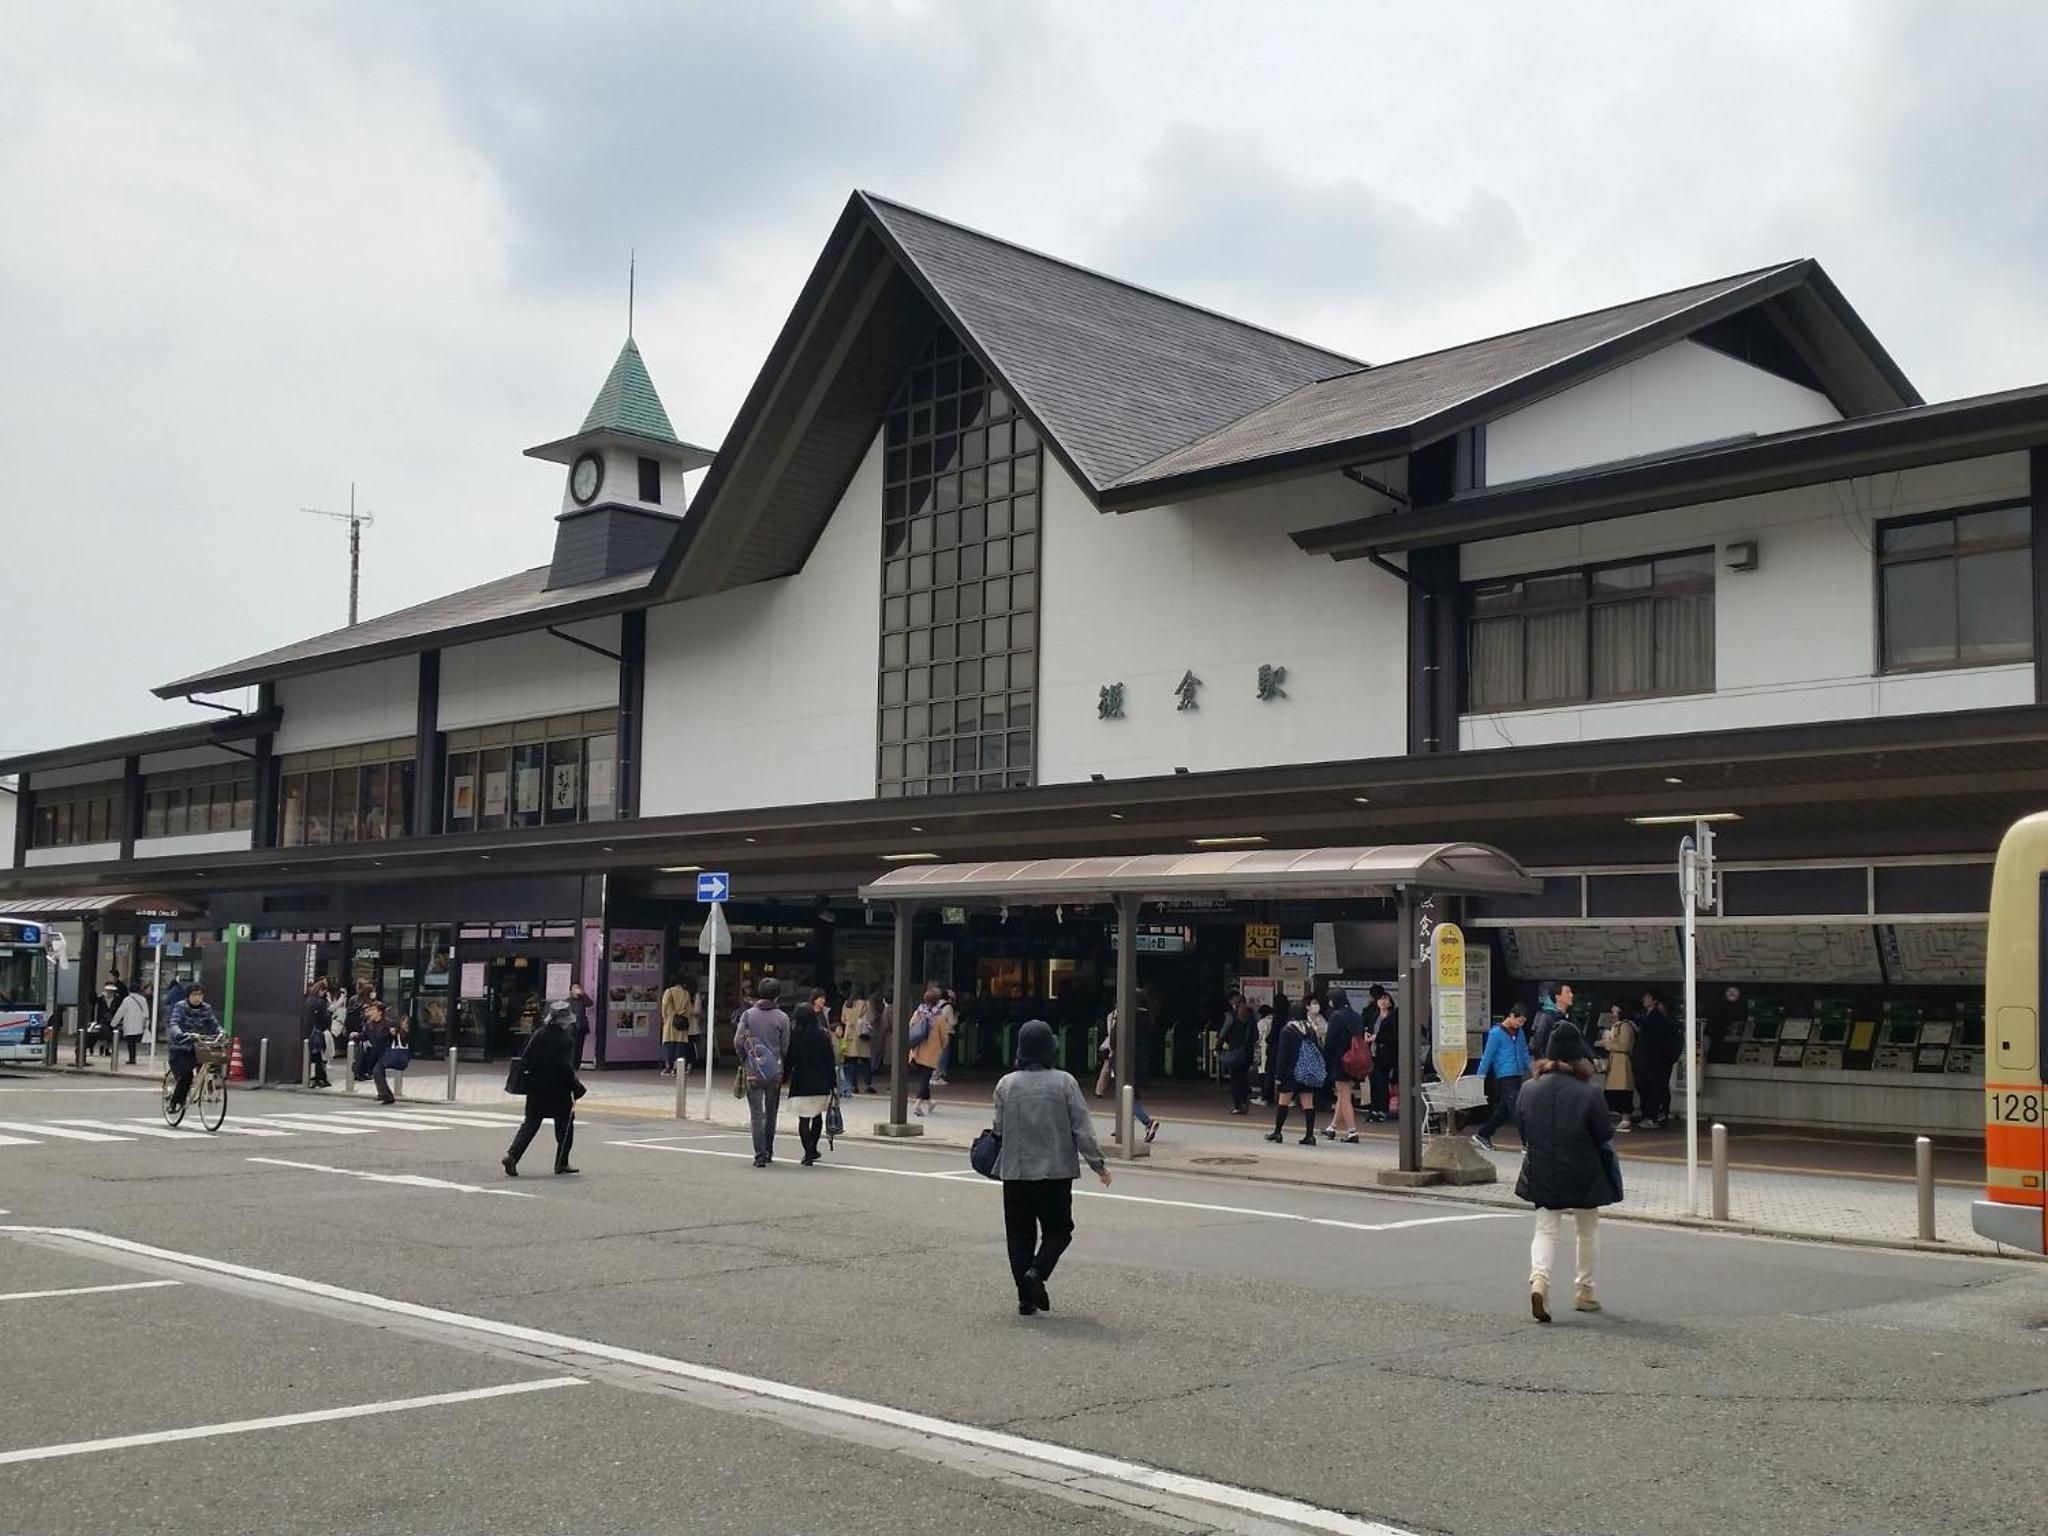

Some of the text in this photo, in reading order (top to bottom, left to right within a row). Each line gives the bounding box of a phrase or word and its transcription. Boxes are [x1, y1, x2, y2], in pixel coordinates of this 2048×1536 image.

[1247, 937, 1278, 949] 入口
[1440, 953, 1462, 964] タクシー
[1992, 1092, 2039, 1122] 128
